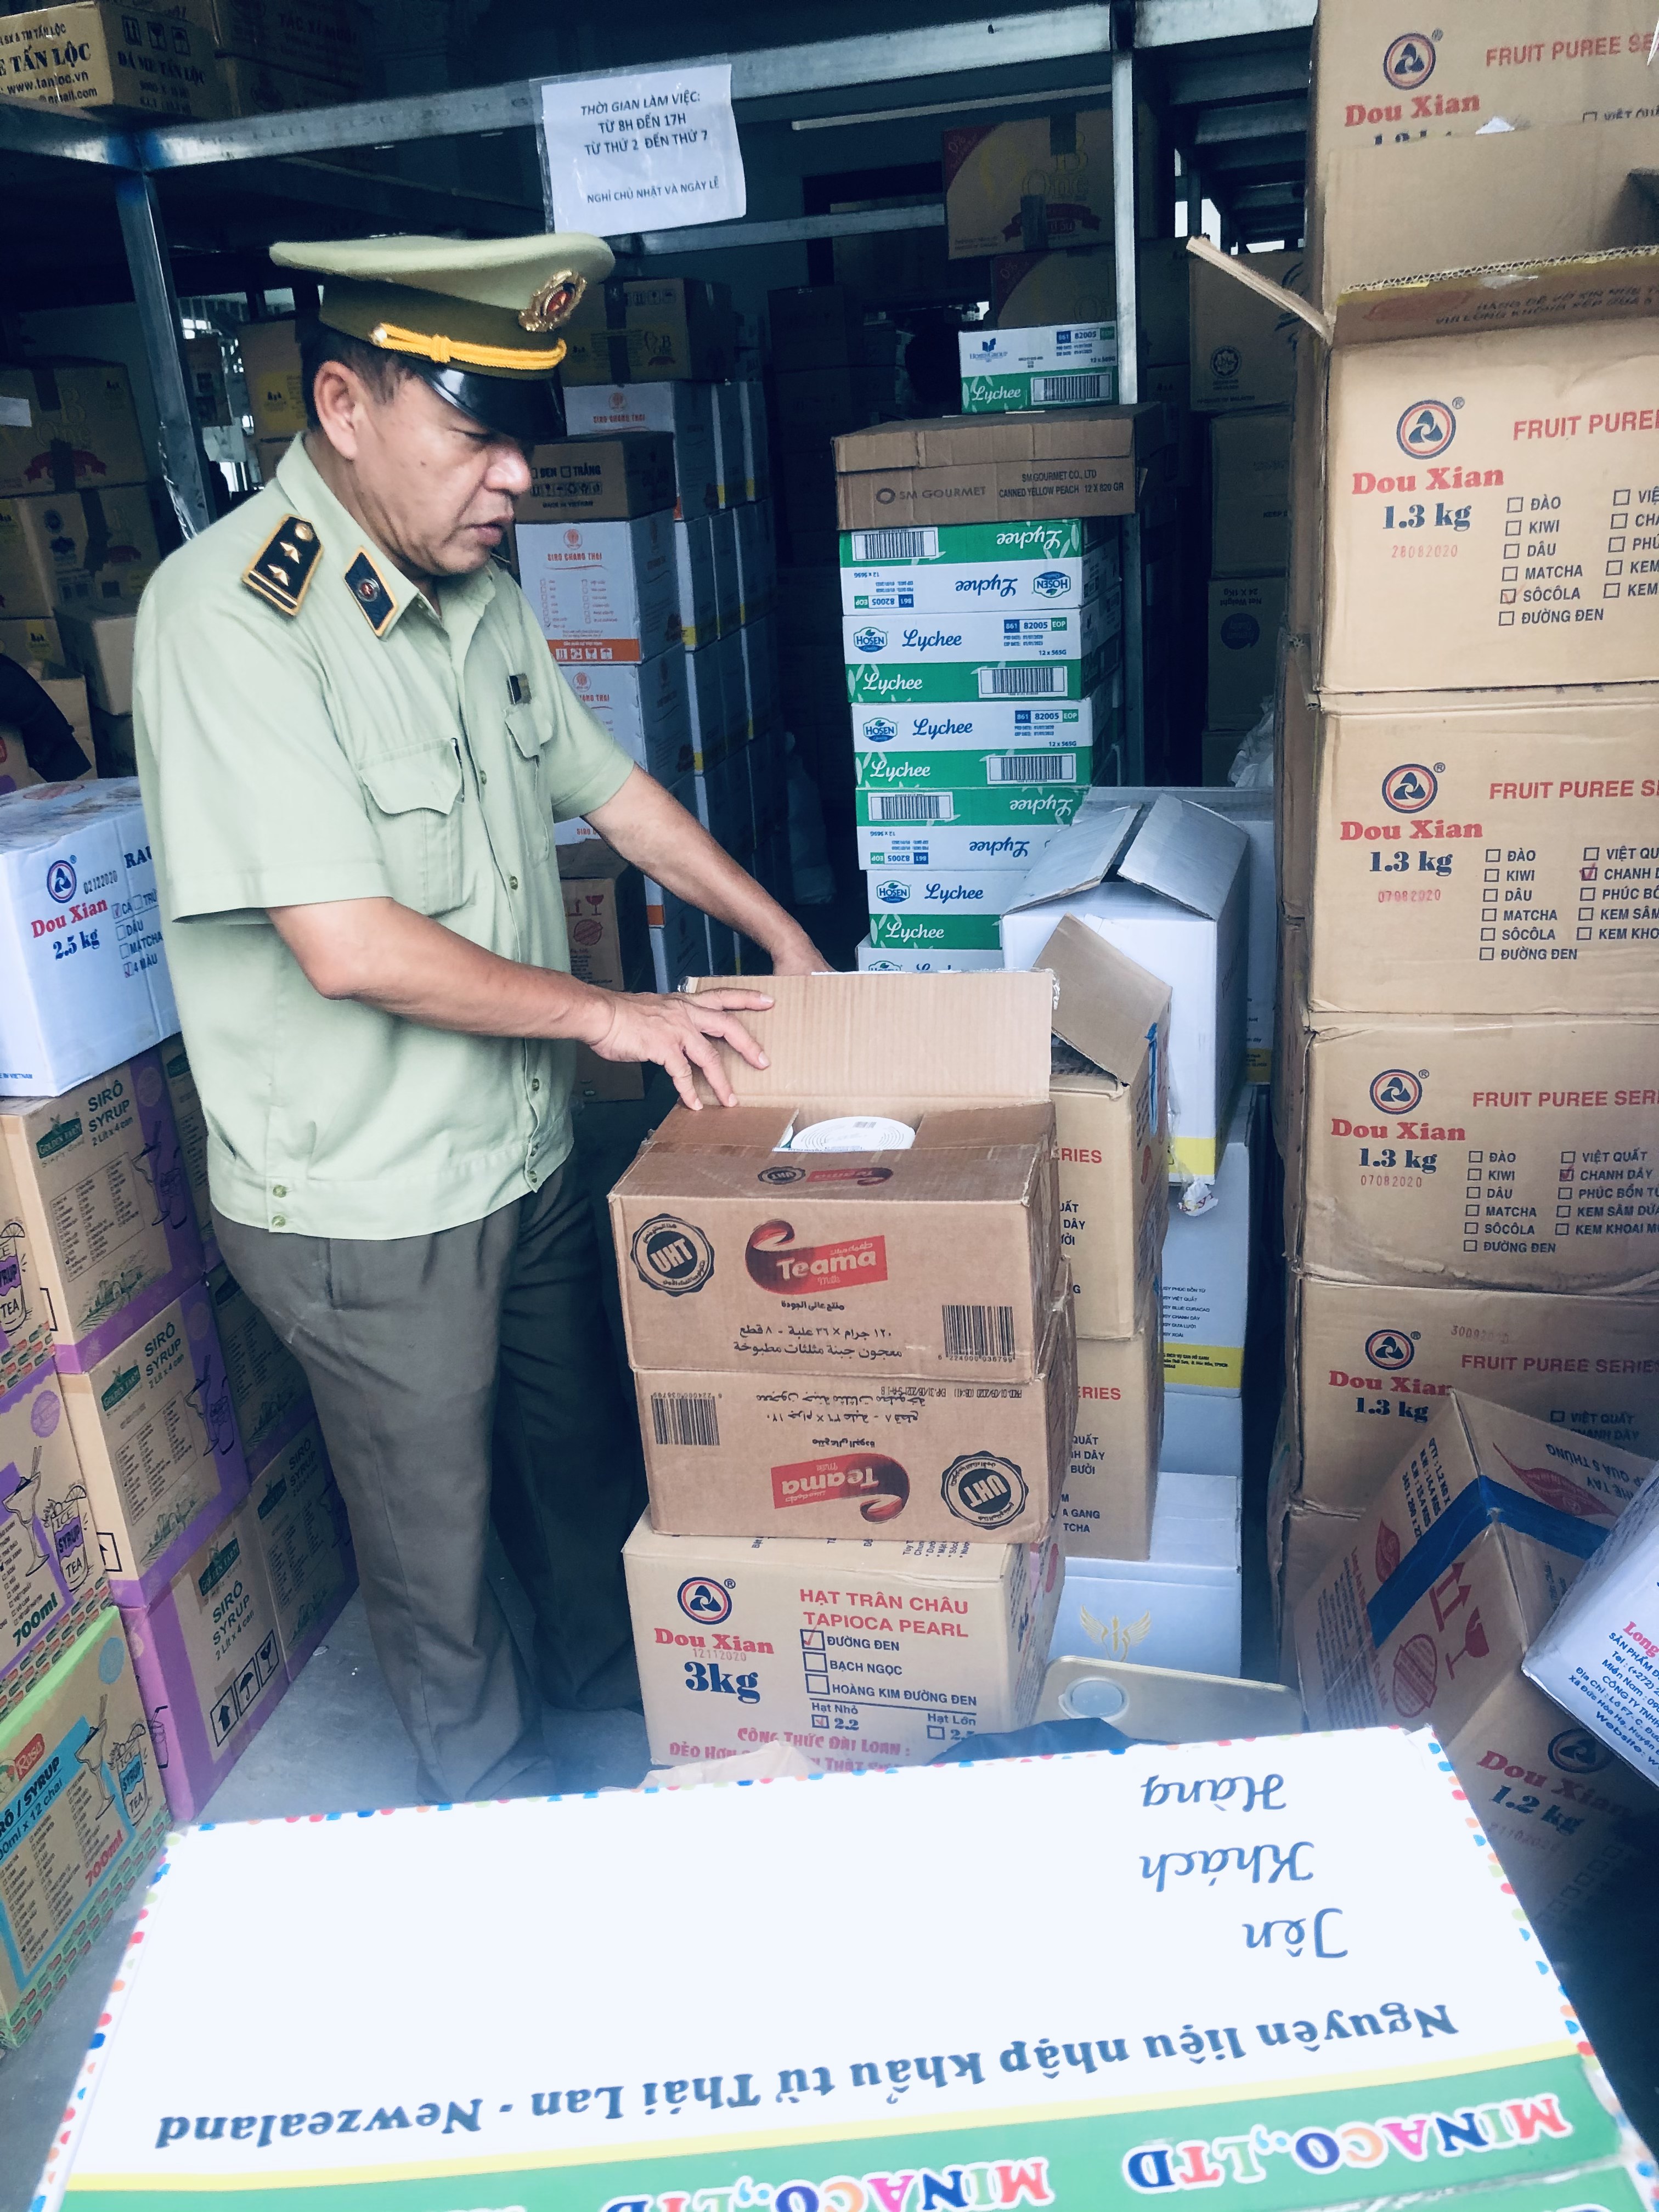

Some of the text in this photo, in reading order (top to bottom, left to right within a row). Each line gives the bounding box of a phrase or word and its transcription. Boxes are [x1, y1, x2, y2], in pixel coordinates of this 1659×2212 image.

[10, 41, 91, 73] TẤN LỘC
[1486, 36, 1621, 67] FRUIT PUREE
[581, 90, 700, 116] THỜI GIAN LÀM VIỆC:
[1345, 94, 1480, 127] Dou Xian
[598, 112, 686, 134] TỪ 8H ĐẾN 17H
[584, 130, 707, 155] TỪ THỨ 2 ĐẾN THỨ 7
[588, 176, 719, 204] NGHỈ CHỦ NHẬT VÀ NGÀY LỄ
[972, 385, 1020, 404] Lychee
[1033, 470, 1067, 481] GOURMET
[1084, 469, 1096, 479] LTD
[1352, 466, 1504, 495] Dou Xian
[900, 486, 986, 500] SM GOURMET
[999, 482, 1124, 499] CANNED YELLOW PEACH 12 X 820 GR
[1383, 503, 1471, 532] 1.3 kg
[996, 526, 1062, 549] Lychee
[1392, 545, 1458, 558] 28082020
[1037, 580, 1068, 589] HOSEN
[1525, 565, 1583, 580] MATCHA
[1523, 588, 1581, 603] SÔCÔLA
[1522, 608, 1604, 625] ĐƯỜNG ĐEN
[856, 635, 884, 645] HOSEN
[902, 629, 962, 651] Lychee
[864, 673, 922, 695] Lychee
[866, 726, 894, 736] HOSEN
[912, 718, 973, 740] Lychee
[870, 761, 930, 782] Lychee
[1489, 780, 1634, 799] FRUIT PUREE
[1340, 820, 1483, 840] Dou Xian
[1369, 851, 1453, 877] 1.3 kg
[879, 888, 907, 897] HOSEN
[924, 884, 983, 903] Lychee
[1378, 889, 1441, 904] 07082020
[31, 899, 108, 938] Dou Xian
[885, 923, 944, 940] Lychee
[53, 928, 100, 960] 2.5 kg
[129, 932, 163, 954] MATCHA
[87, 1080, 123, 1113] SIRÔ
[1473, 1091, 1607, 1107] FRUIT PUREE
[88, 1100, 131, 1133] SYRUP
[1330, 1119, 1466, 1141] Dou Xian
[1358, 1148, 1437, 1174] 1.3 kg
[1582, 1147, 1648, 1165] VIỆT QUẤT
[1361, 1175, 1422, 1188] 07082020
[1579, 1167, 1652, 1181] CHANH DÂY
[651, 1239, 692, 1273] UHT
[776, 1249, 877, 1280] Teama
[145, 1322, 176, 1357] SIRÔ
[844, 1328, 870, 1340] جرام
[146, 1338, 182, 1376] SYRUP
[733, 1341, 902, 1360] معجون جبنة مثلثات مطبوخة
[1462, 1355, 1589, 1373] FRUIT PUREE
[782, 1466, 879, 1493] Teama
[963, 1473, 1008, 1506] UHT
[59, 1525, 81, 1554] SYRUP
[66, 1558, 84, 1580] TEA
[212, 1582, 244, 1623] SIRÔ
[800, 1589, 968, 1615] HẠT TRÂN CHÂU
[13, 1592, 58, 1646] 700ml
[213, 1596, 251, 1645] SYRUP
[804, 1611, 968, 1638] TAPIOCA PEARL
[654, 1628, 774, 1655] Dou Xian
[827, 1634, 900, 1651] ĐƯỜNG ĐEN
[1609, 1633, 1653, 1672] SẢN PHẨM
[693, 1648, 747, 1662] 12112020
[830, 1660, 902, 1677] BẠCH NGỌC
[685, 1661, 760, 1704] 3kg
[832, 1680, 977, 1706] HOÀNG KIM ĐƯỜNG ĐEN
[1602, 1675, 1640, 1707] CÔNG TY
[24, 1756, 60, 1807] SYRUP
[1476, 1750, 1547, 1788] Dou
[1141, 1773, 1287, 1812] Hàng
[1490, 1785, 1584, 1836] 1.2 kg
[85, 1829, 124, 1887] 700ml
[1139, 1841, 1314, 1892] Khách
[1242, 1907, 1348, 1959] Tên
[155, 2001, 1459, 2149] Nguyên liệu nhập khẩu từ Thái Lan Newzealand
